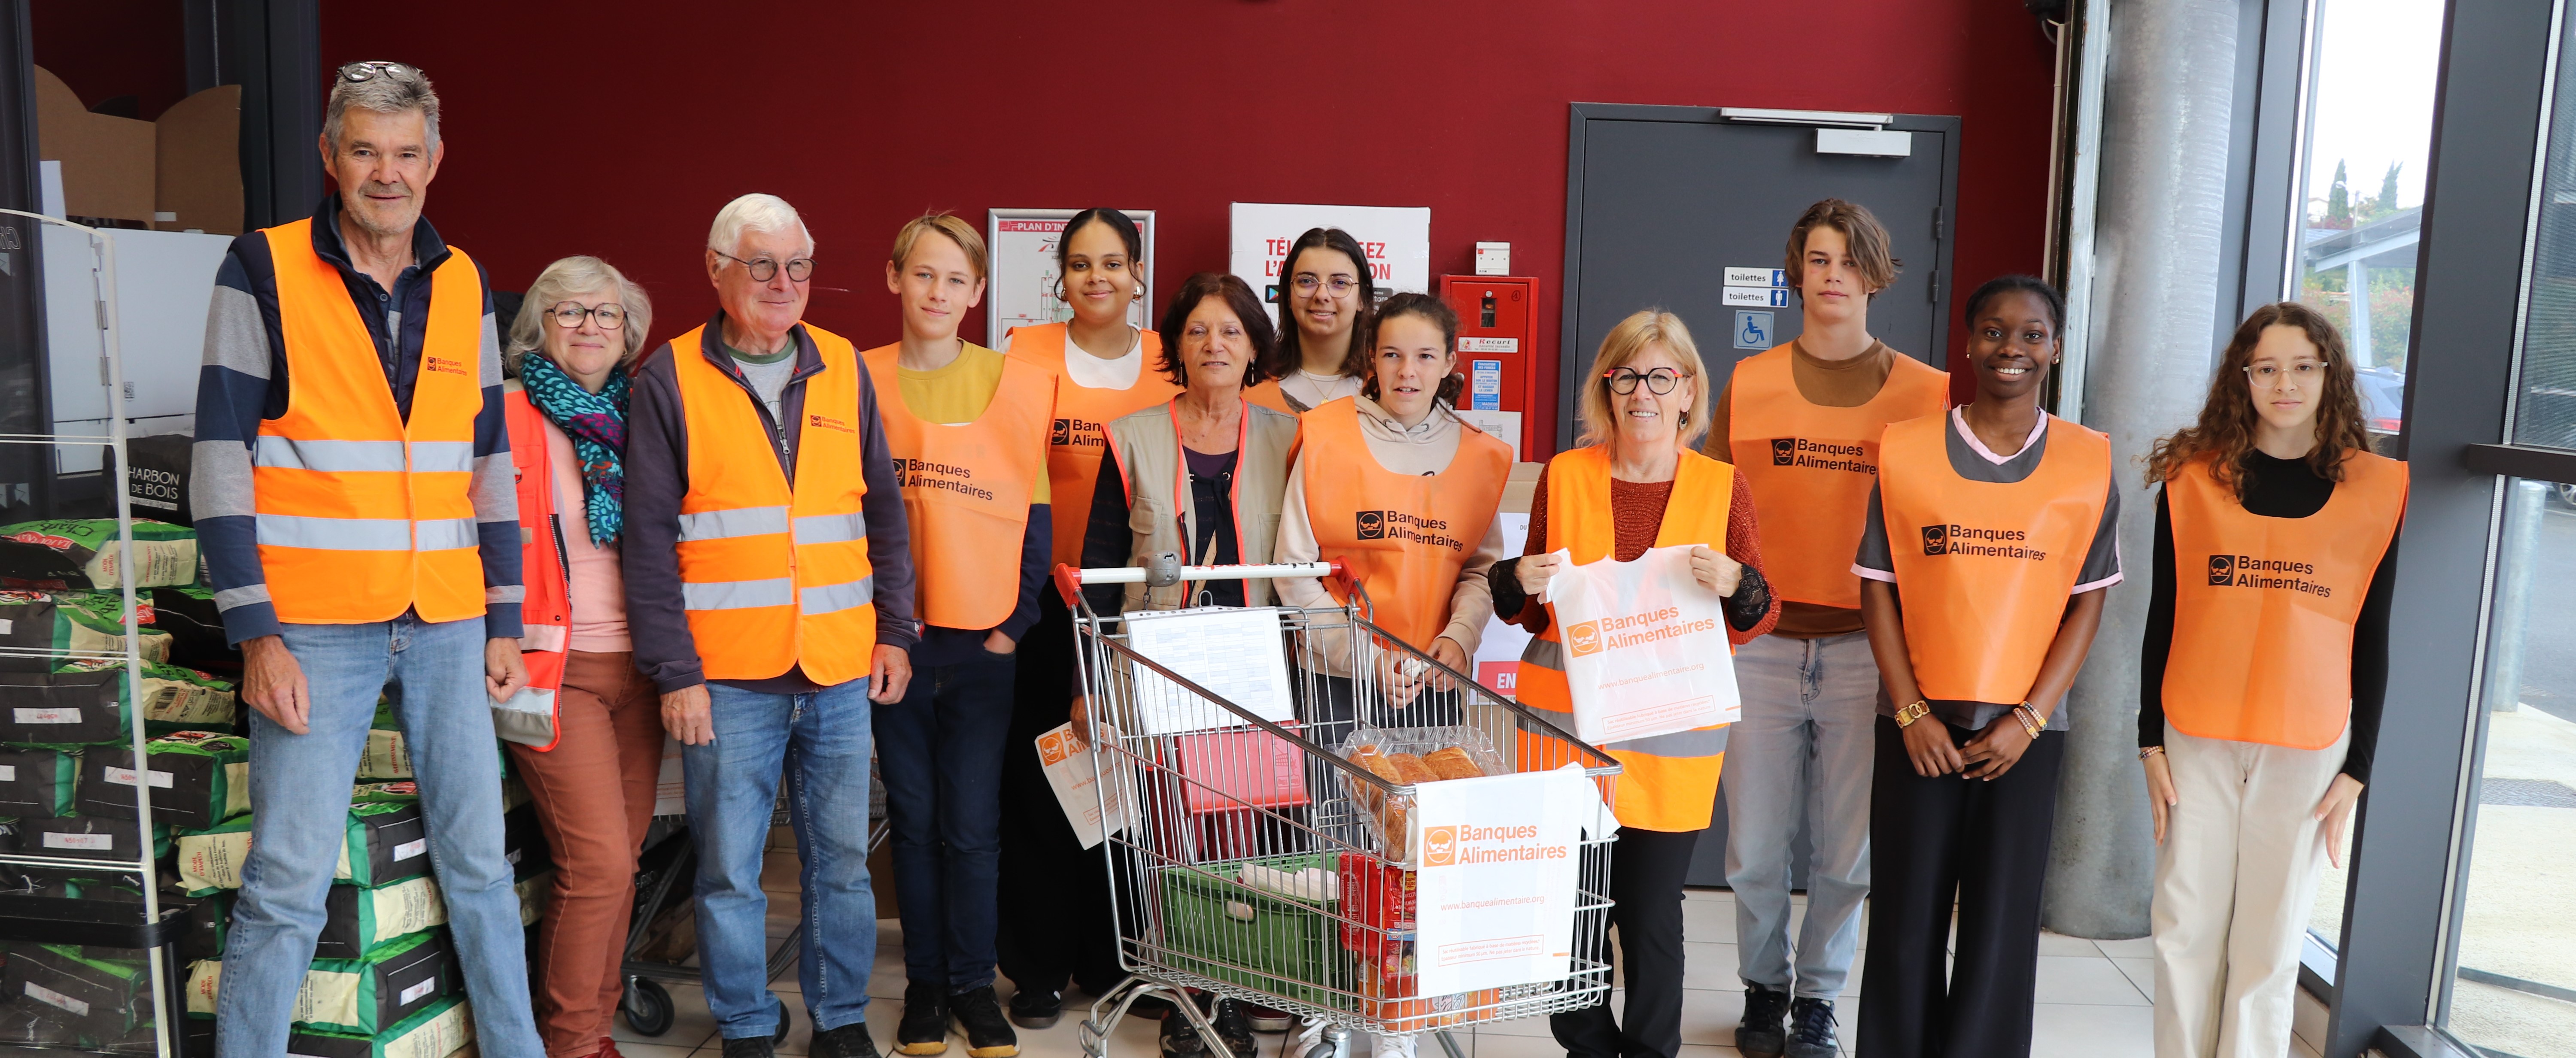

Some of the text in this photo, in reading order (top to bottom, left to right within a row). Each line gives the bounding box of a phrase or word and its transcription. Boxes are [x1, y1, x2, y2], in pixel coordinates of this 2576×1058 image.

[1729, 293, 1764, 301] toilettes
[437, 358, 462, 367] Banques
[437, 366, 468, 376] Alimentaires
[822, 416, 845, 426] Banques
[823, 423, 855, 434] Alimentaires
[1797, 438, 1863, 457] Banques
[908, 458, 971, 478] Banques
[1795, 455, 1877, 475] Alimentaire
[128, 466, 179, 485] HARBON
[131, 483, 178, 499] DE BOIS
[908, 475, 993, 500] Alimentaires
[1387, 510, 1446, 530] Banques
[1387, 526, 1463, 552] Alimentaires
[1950, 524, 2025, 543] Banques
[1948, 541, 2046, 561] Alimentaires
[2238, 555, 2313, 575] Banques
[2236, 573, 2331, 598] Alimentaires
[1601, 606, 1679, 633] Banques
[1607, 618, 1715, 650] Alimentaires
[1598, 663, 1704, 690] www.banquealimentaire.org
[1460, 825, 1537, 843] Banques
[1459, 843, 1567, 864] Alimentaires
[1441, 895, 1544, 911] www.banquealimentaire.org
